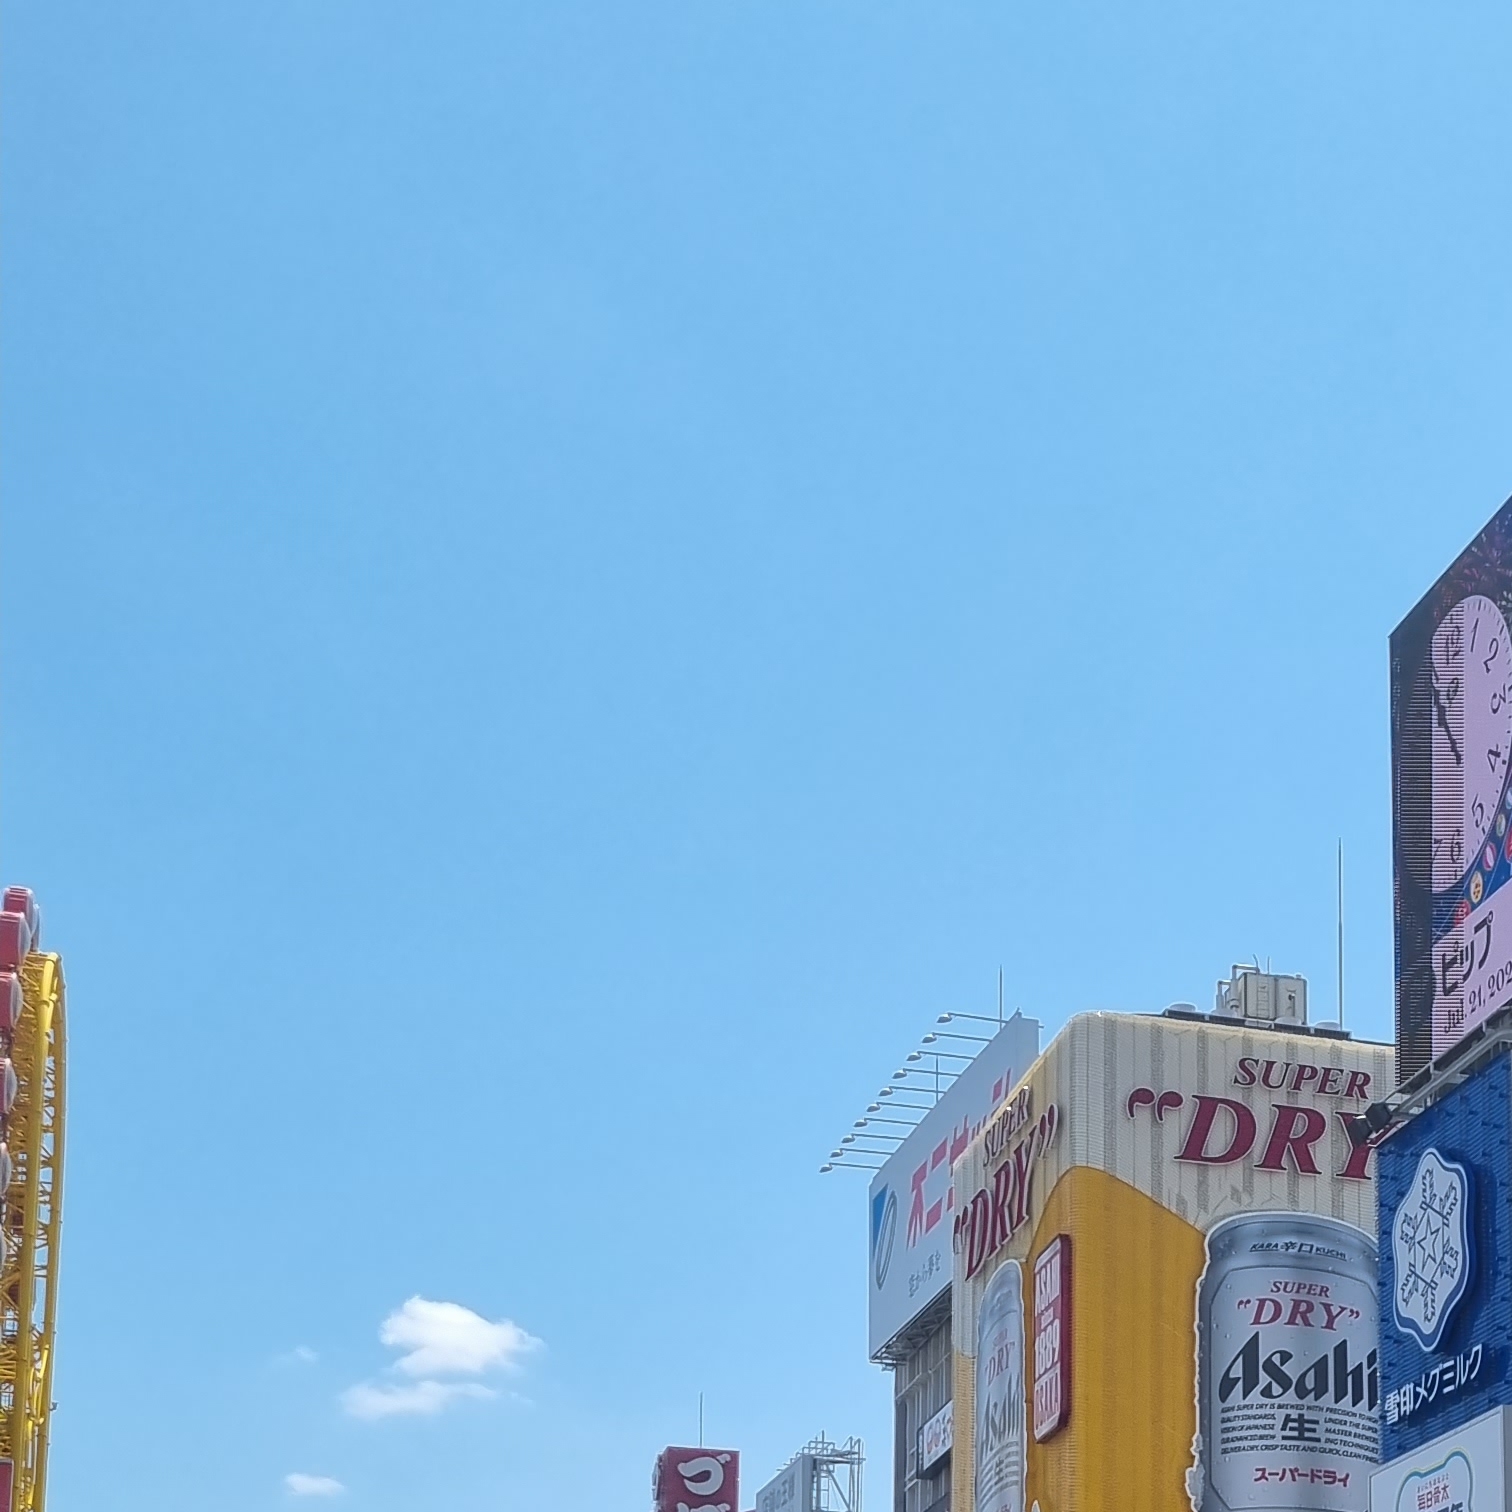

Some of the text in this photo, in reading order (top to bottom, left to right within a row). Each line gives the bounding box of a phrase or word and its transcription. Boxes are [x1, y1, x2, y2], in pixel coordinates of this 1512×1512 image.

[1442, 911, 1494, 996] ピップ
[1233, 1057, 1372, 1100] SUPER
[983, 1089, 1030, 1167] SUPER
[1250, 1242, 1280, 1251] KARA
[1315, 1247, 1347, 1261] KUCHI
[1270, 1281, 1330, 1298] SUPER
[1035, 1319, 1059, 1378] 1889
[1219, 1331, 1378, 1411] Asahi
[1384, 1344, 1482, 1425] 雪印メグミルク
[1280, 1413, 1321, 1443] 生
[1254, 1466, 1350, 1488] スーパードライ
[1417, 1484, 1449, 1511] 毎日骨太
